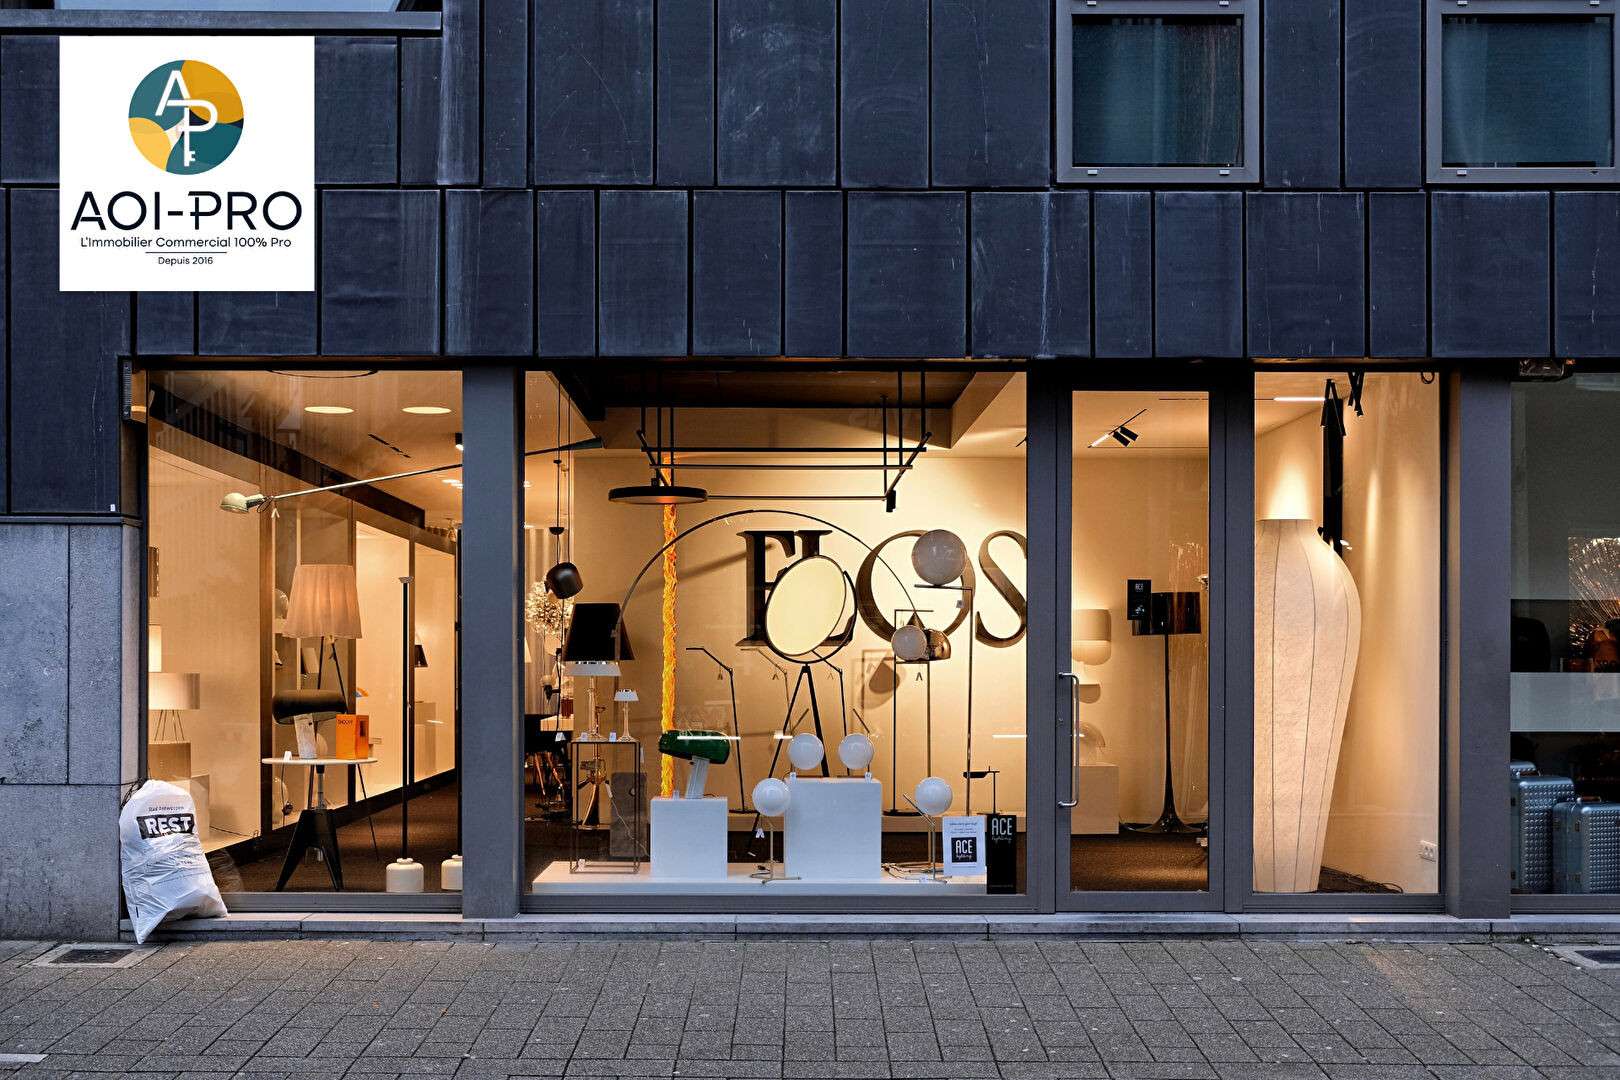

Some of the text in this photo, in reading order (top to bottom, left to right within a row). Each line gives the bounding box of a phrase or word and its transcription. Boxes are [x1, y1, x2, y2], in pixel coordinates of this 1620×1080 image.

[144, 816, 192, 835] REST
[991, 817, 1013, 836] ACE
[955, 839, 973, 854] ACE
